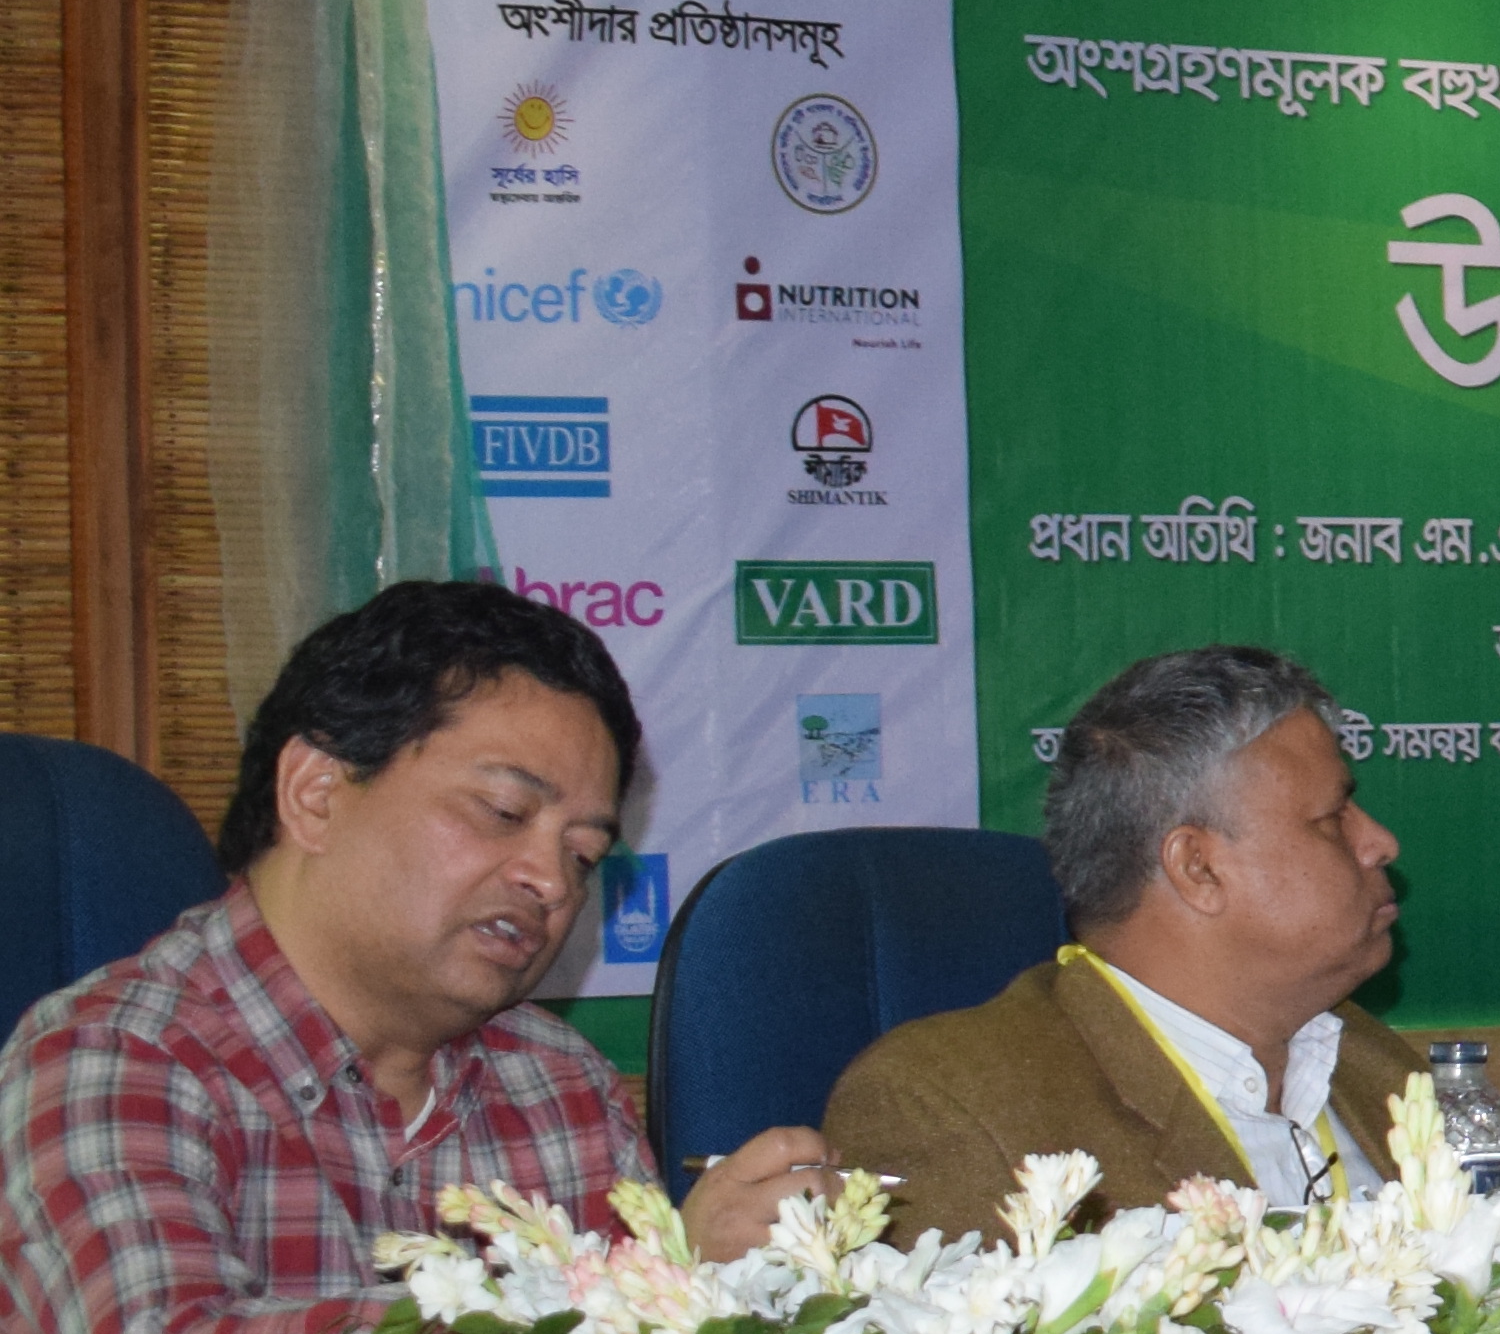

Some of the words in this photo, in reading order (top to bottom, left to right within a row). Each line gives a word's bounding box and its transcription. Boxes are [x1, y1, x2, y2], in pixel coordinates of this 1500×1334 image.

[650, 0, 844, 69] প্রতিষ্ঠানসমূহ
[1025, 34, 1385, 117] অংশগ্রহণমূলক
[542, 164, 580, 186] হাসি
[453, 267, 587, 323] nicef
[778, 284, 920, 309] NUTRITION
[778, 308, 921, 327] INTERNATIONAL
[483, 426, 600, 465] FIVDB
[788, 489, 888, 505] SHIMANTIK
[1029, 513, 1131, 561] প্রধান
[1140, 495, 1256, 562] অতিথি
[1297, 516, 1403, 563] জনাব
[750, 578, 923, 628] VARD
[1382, 723, 1481, 762] সমন্বয়
[803, 780, 880, 803] ERA
